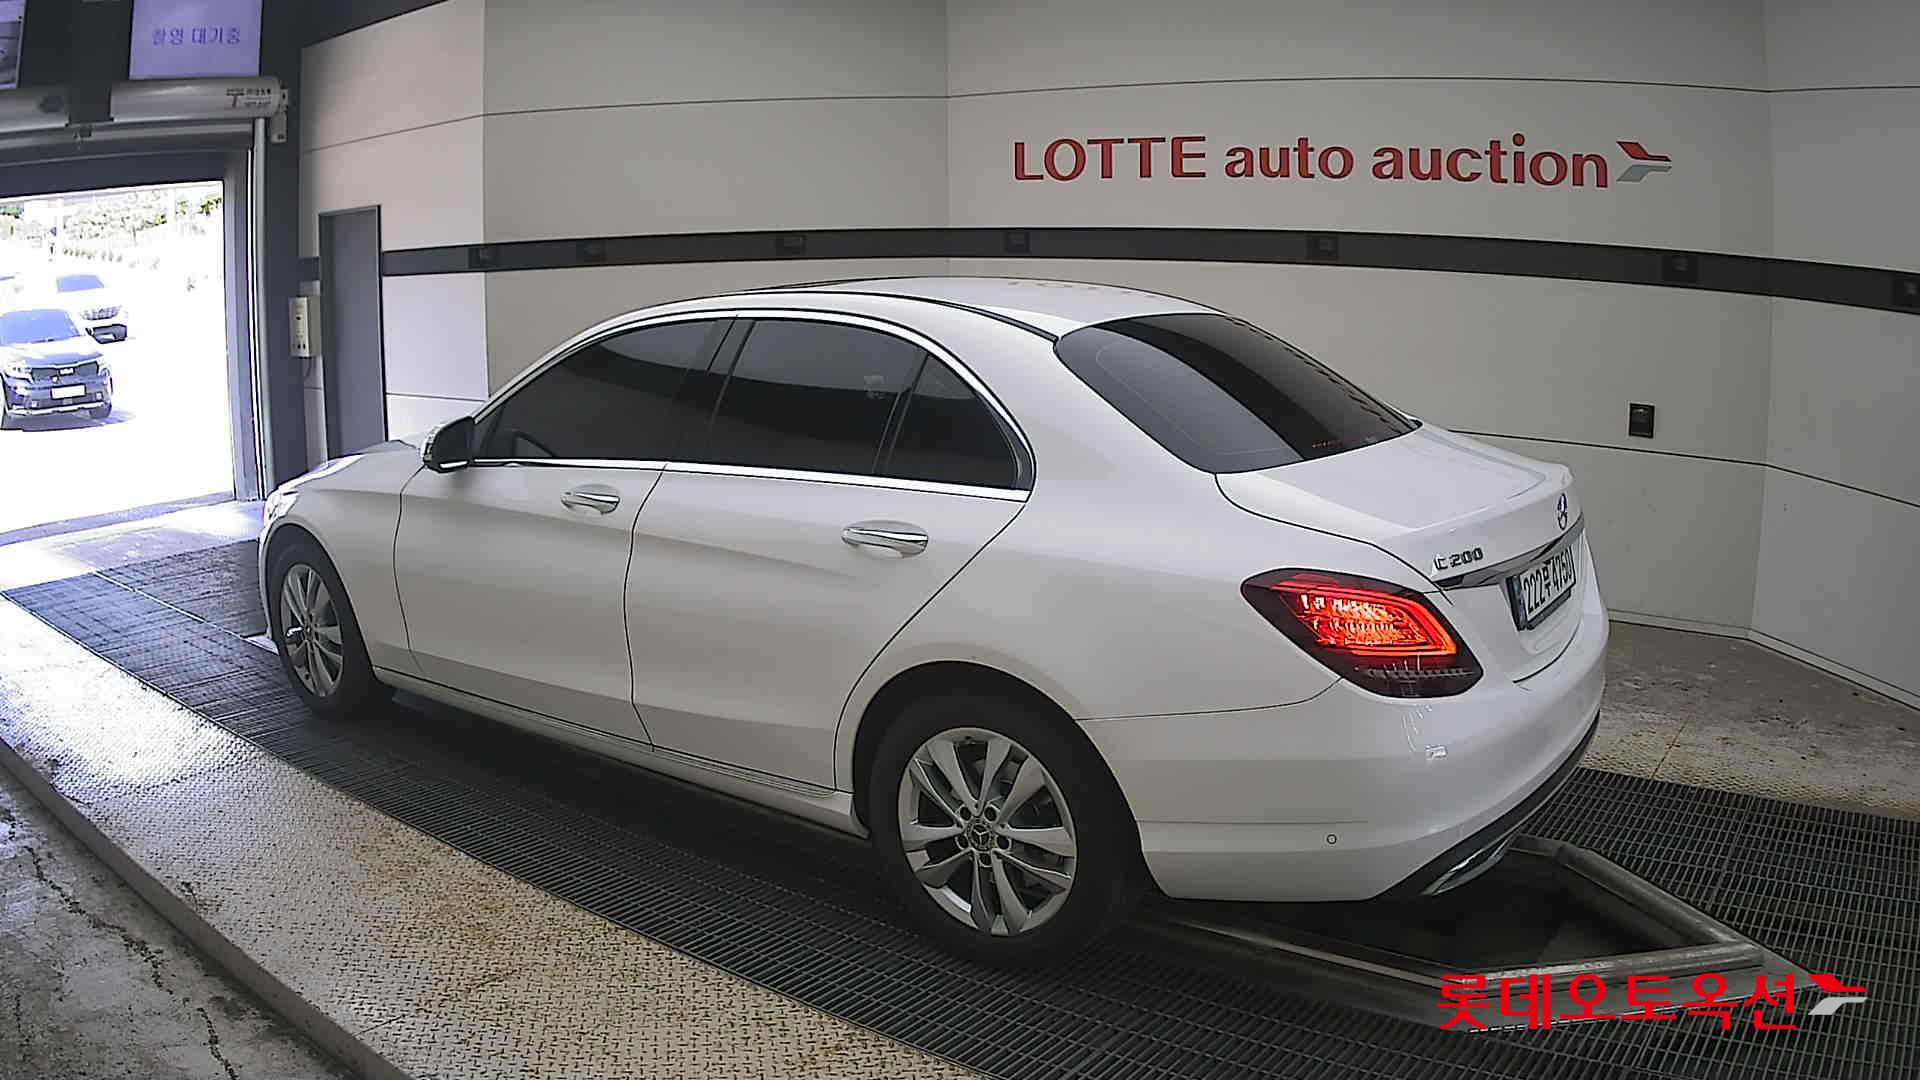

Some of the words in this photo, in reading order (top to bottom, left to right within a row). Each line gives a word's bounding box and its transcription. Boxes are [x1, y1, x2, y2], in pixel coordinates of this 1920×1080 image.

[191, 26, 241, 45] 대기중
[1014, 136, 1206, 181] LOTTE
[1224, 137, 1354, 179] auto
[1372, 134, 1608, 188] auction
[1433, 556, 1449, 570] C
[1449, 547, 1483, 568] 200
